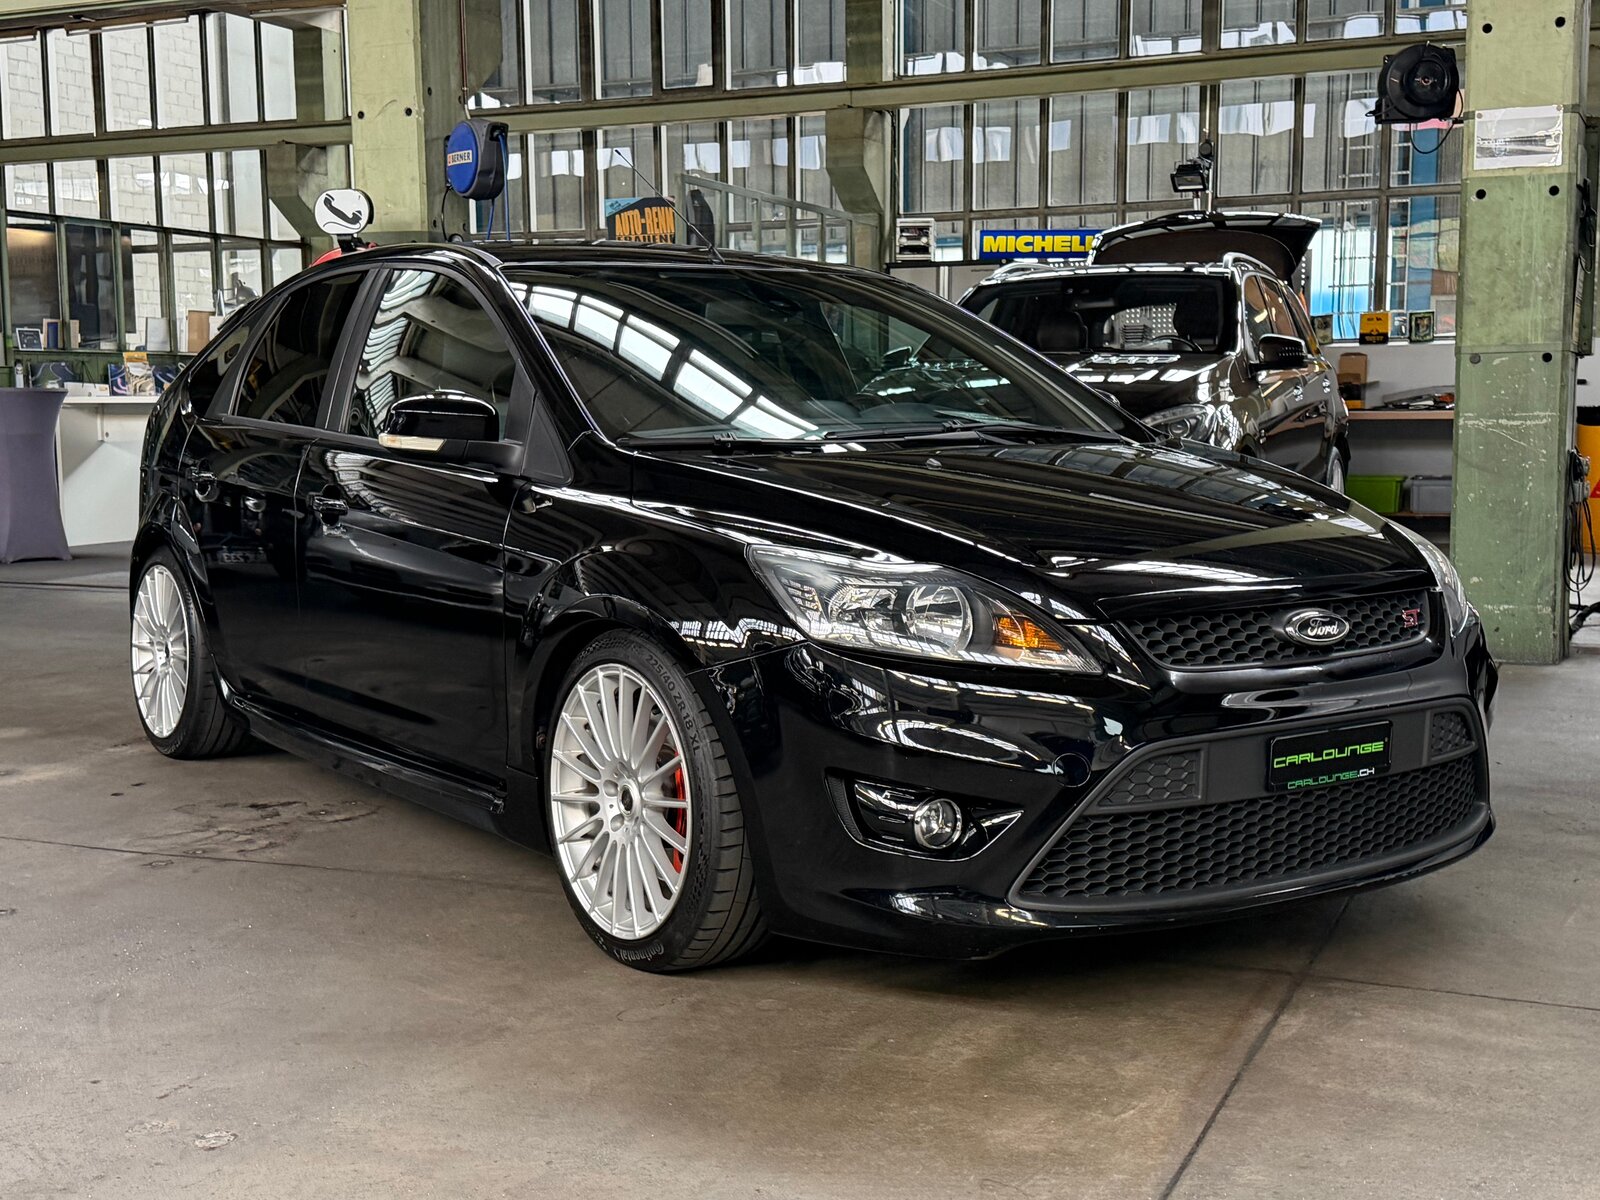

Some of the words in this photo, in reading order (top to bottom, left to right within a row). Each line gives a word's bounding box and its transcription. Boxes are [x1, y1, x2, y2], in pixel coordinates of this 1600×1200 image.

[1307, 617, 1339, 636] Ford
[1402, 608, 1420, 628] ST
[645, 654, 676, 692] 225/40
[683, 712, 694, 730] 18
[689, 733, 701, 756] XL
[1273, 741, 1384, 769] CARLOUNGE
[1287, 767, 1375, 789] CARLOUNGE.CH
